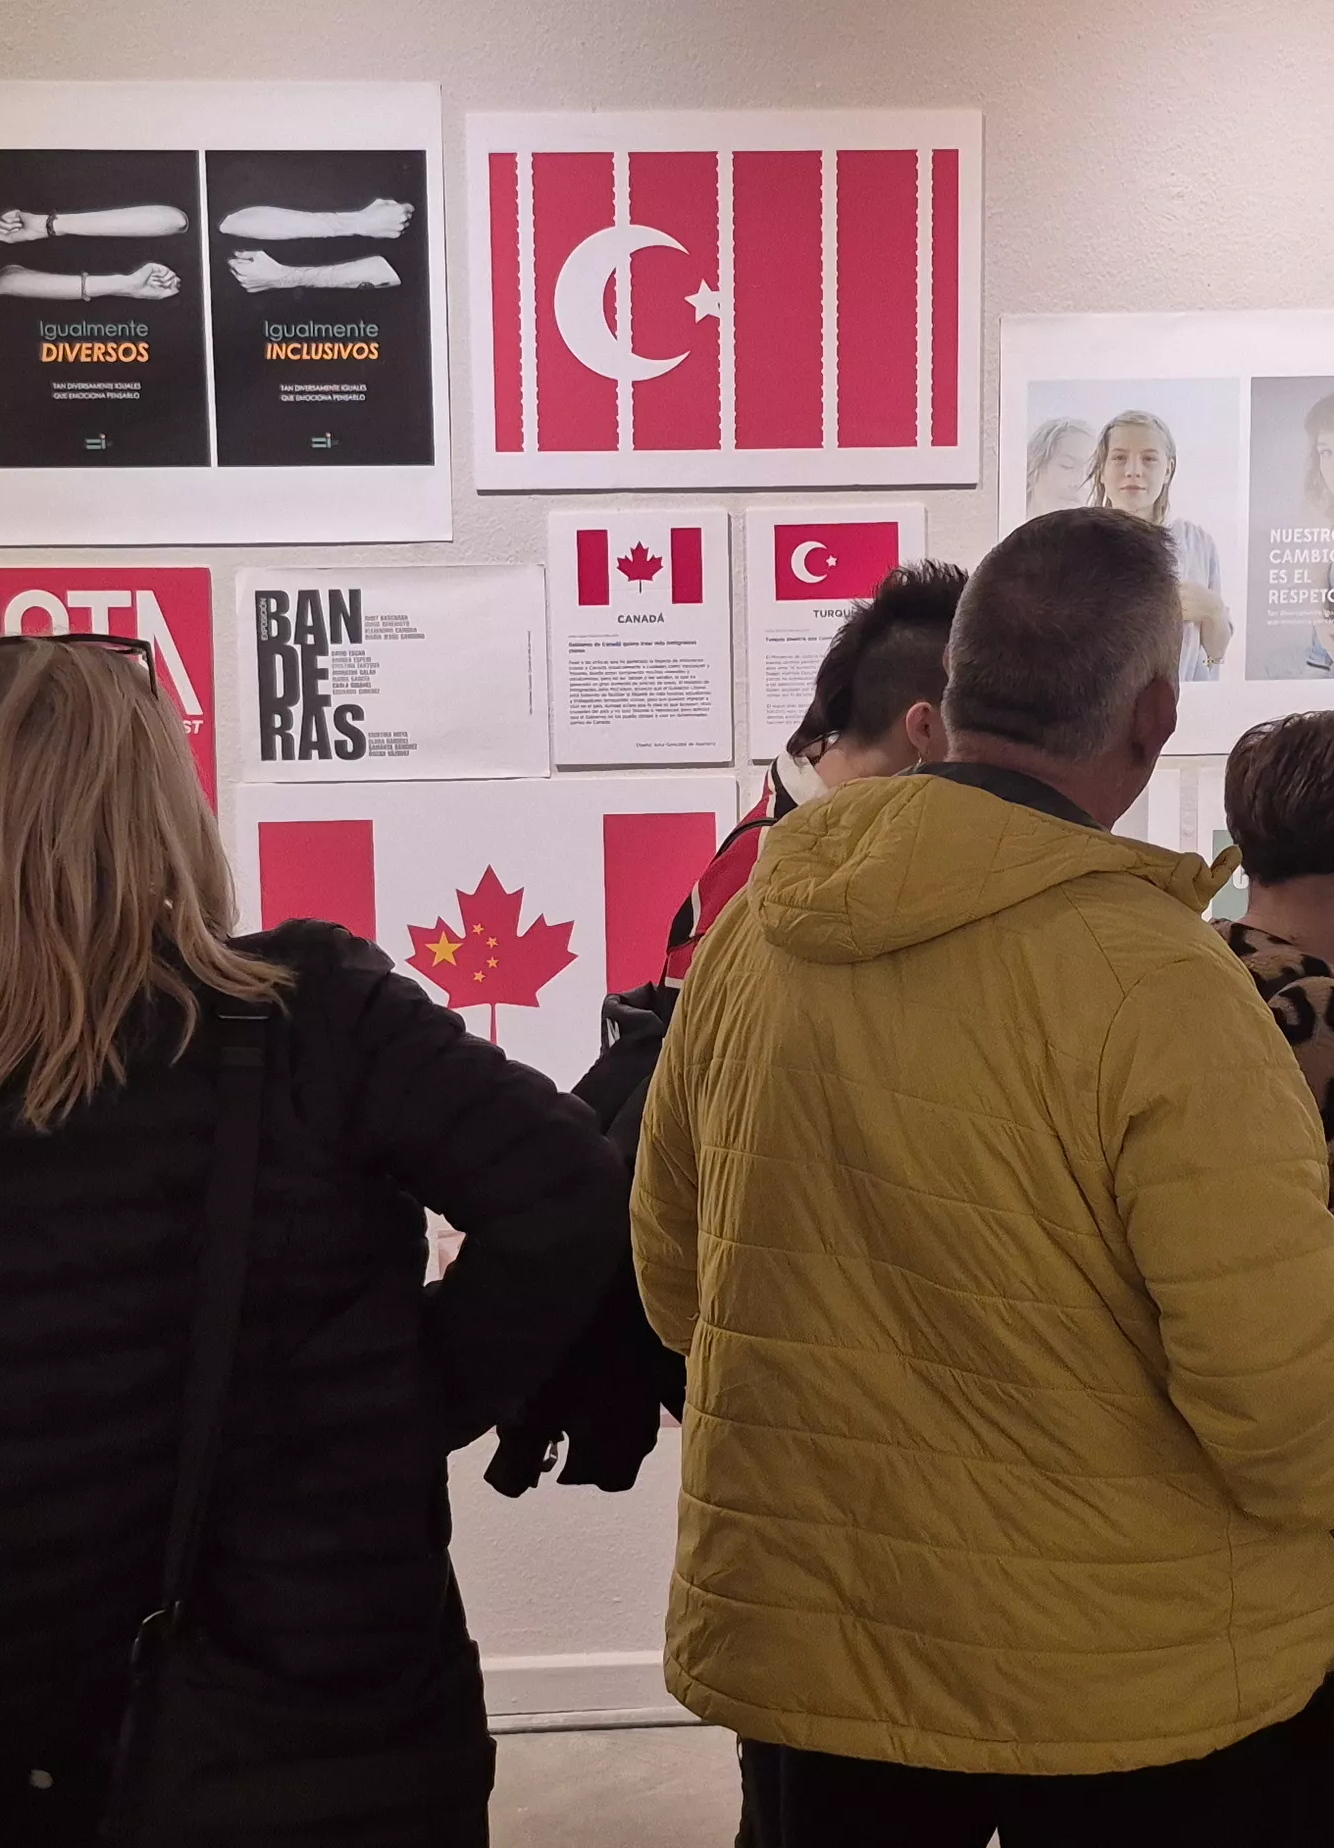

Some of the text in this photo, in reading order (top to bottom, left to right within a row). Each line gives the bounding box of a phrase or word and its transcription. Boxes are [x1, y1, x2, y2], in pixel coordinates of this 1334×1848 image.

[40, 320, 149, 341] Igualmente
[264, 320, 379, 341] Igualmente
[41, 342, 149, 362] DIVERSOS
[266, 342, 379, 360] INCLUSIVOS
[1269, 569, 1312, 584] ES EL
[255, 589, 363, 645] BAN
[617, 612, 665, 624] CANADÁ
[257, 641, 332, 707] DE
[260, 704, 367, 761] RAS
